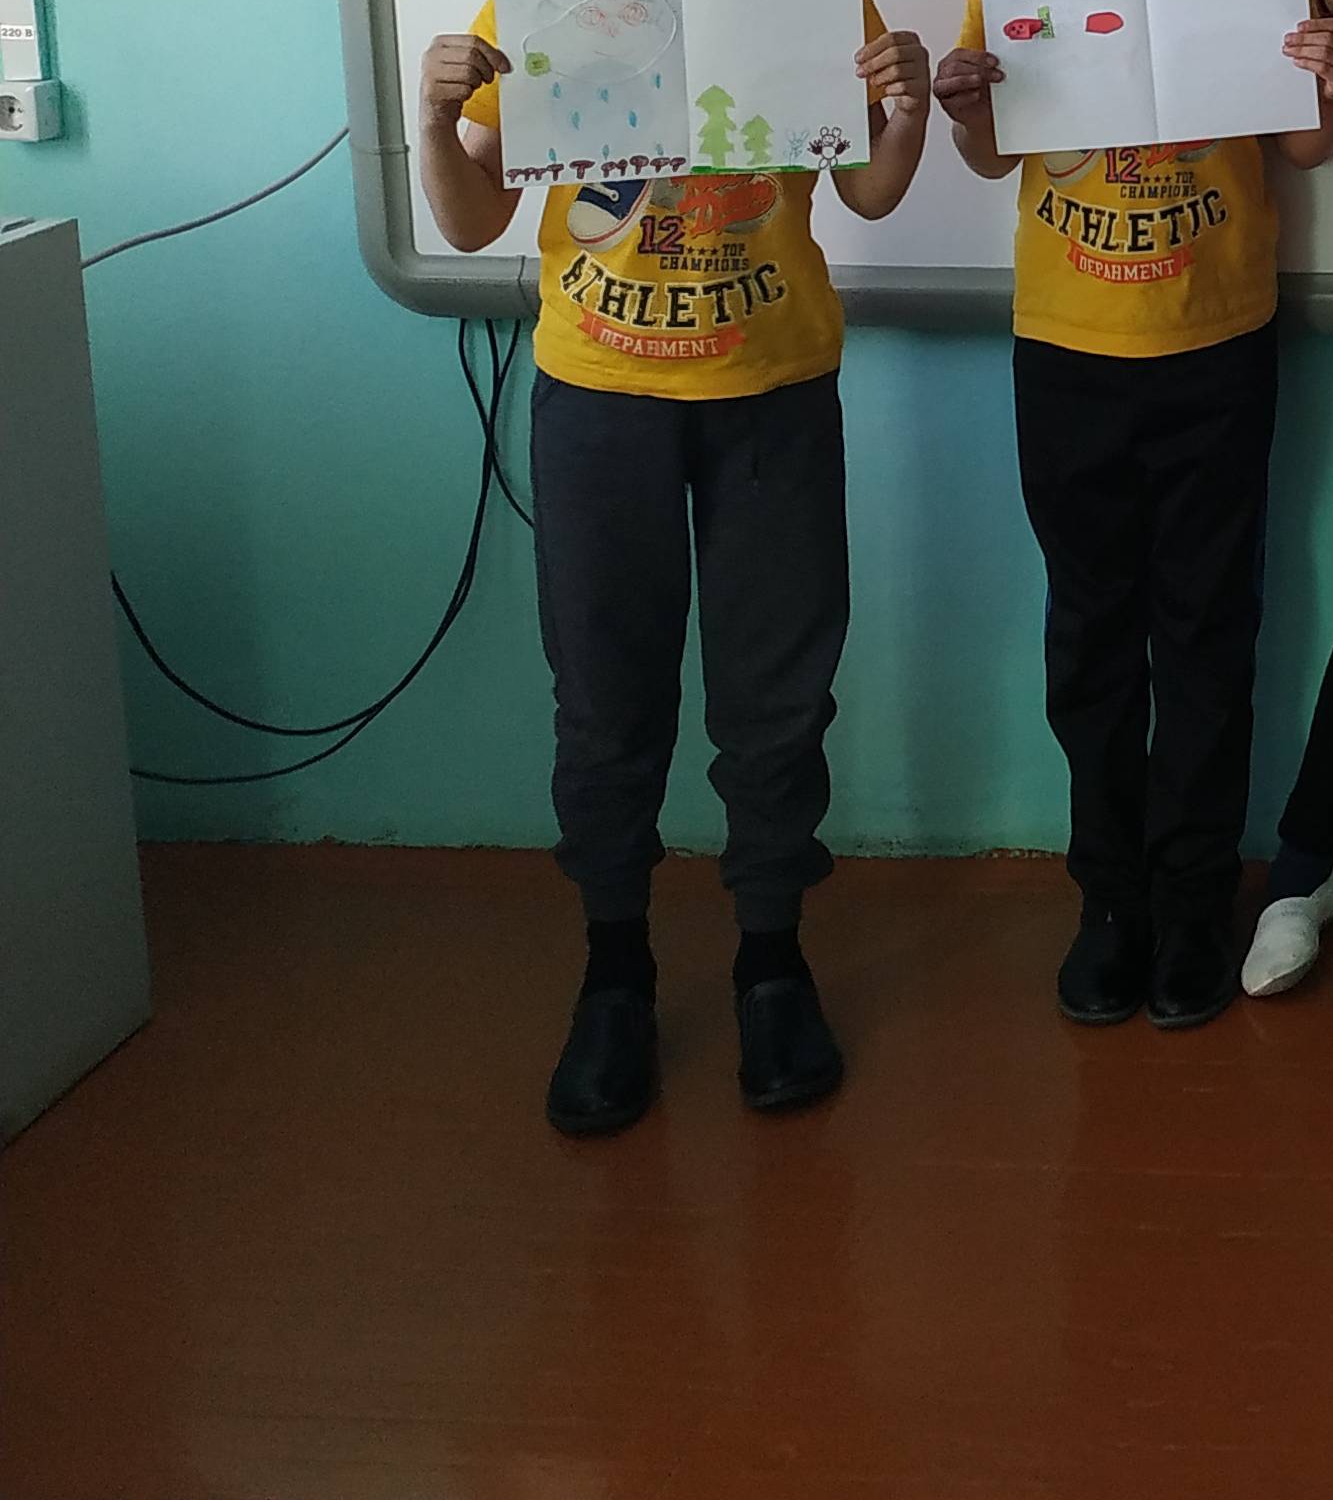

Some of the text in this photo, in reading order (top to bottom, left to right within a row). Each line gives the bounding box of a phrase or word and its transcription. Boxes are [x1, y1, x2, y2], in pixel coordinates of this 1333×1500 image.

[1, 27, 22, 38] 220
[1105, 147, 1141, 184] 12
[1175, 171, 1194, 184] TOP
[1120, 185, 1197, 199] CHAMPIONS
[1035, 185, 1228, 254] ATHLETIC
[637, 215, 685, 255] 12
[722, 243, 746, 257] TOP
[659, 256, 750, 272] CHAMPIONS
[560, 250, 787, 329] ATHLETIC
